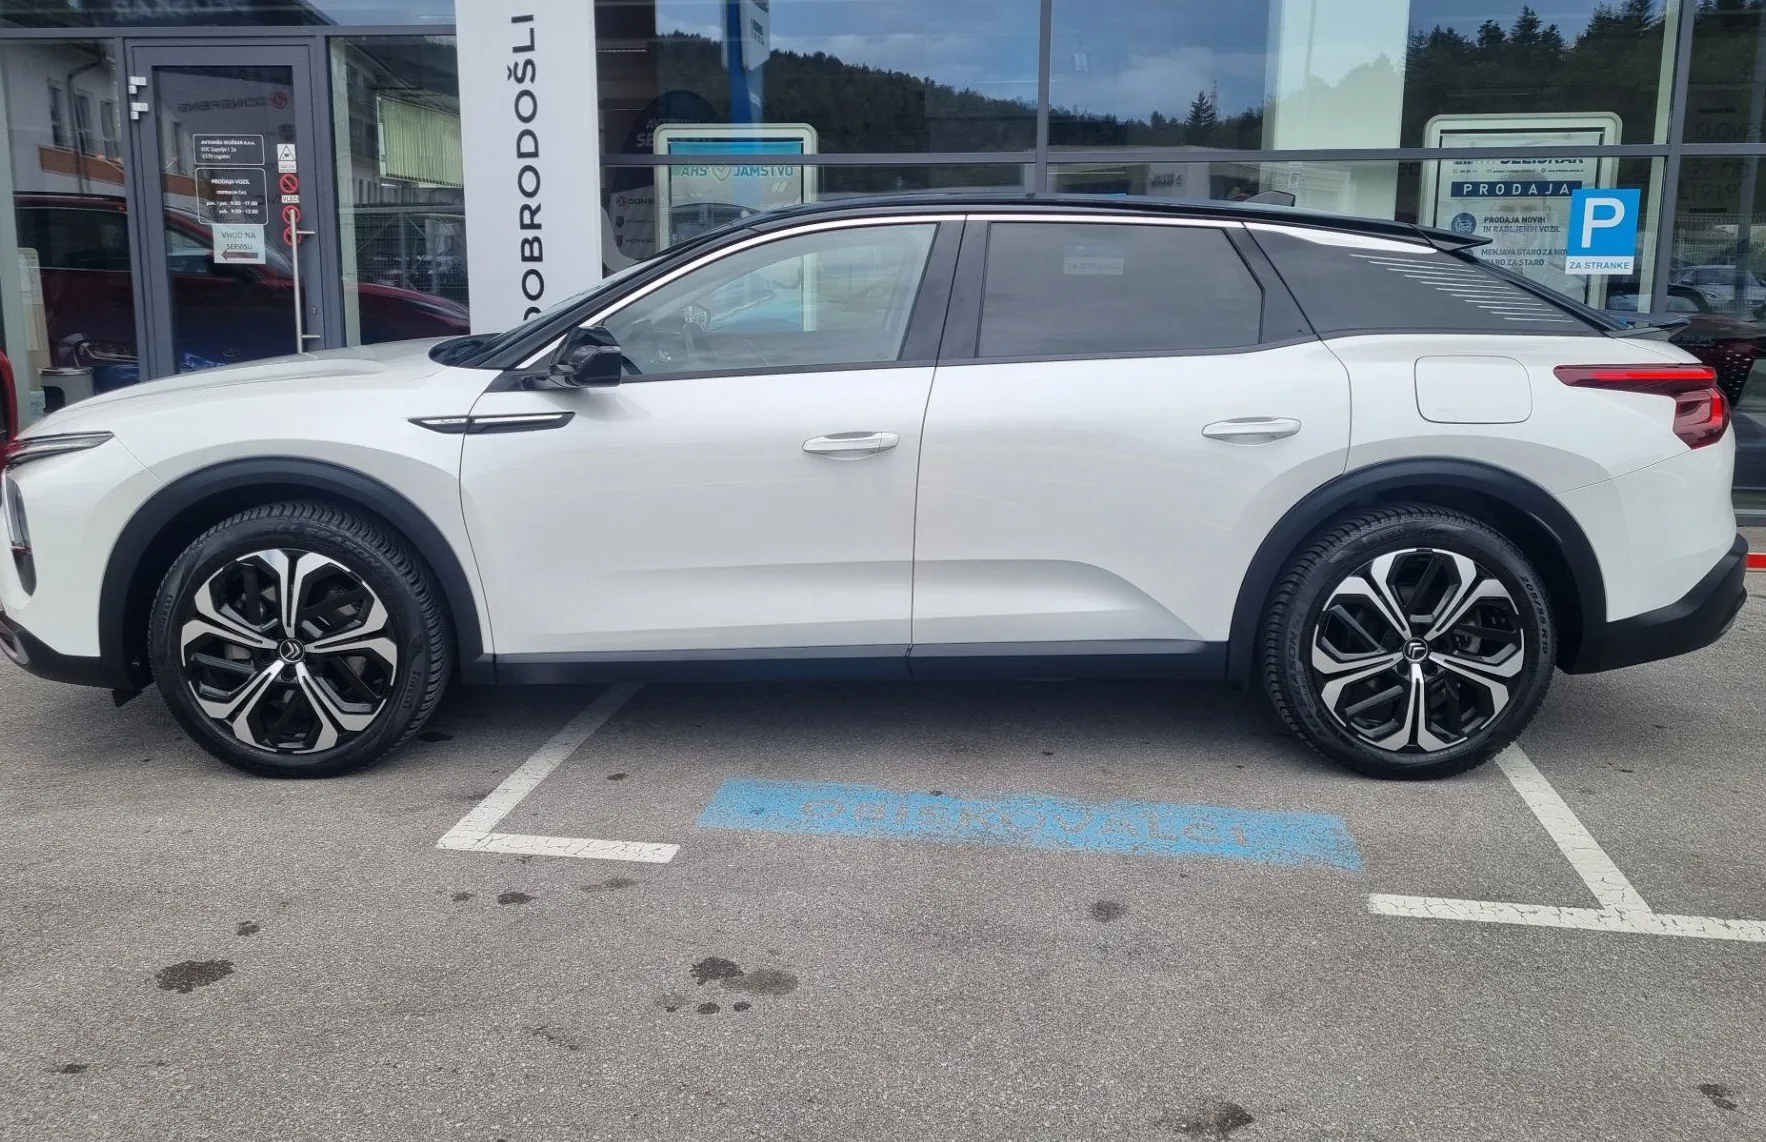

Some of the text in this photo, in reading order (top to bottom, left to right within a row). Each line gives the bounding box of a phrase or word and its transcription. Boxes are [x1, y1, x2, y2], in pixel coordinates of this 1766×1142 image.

[1463, 183, 1569, 195] PRODAJA
[1484, 216, 1546, 224] PRODAJA NOVIH
[1581, 197, 1625, 248] P
[1569, 261, 1630, 270] ZA STRANKE
[803, 799, 1248, 847] OBISKOVALCI
